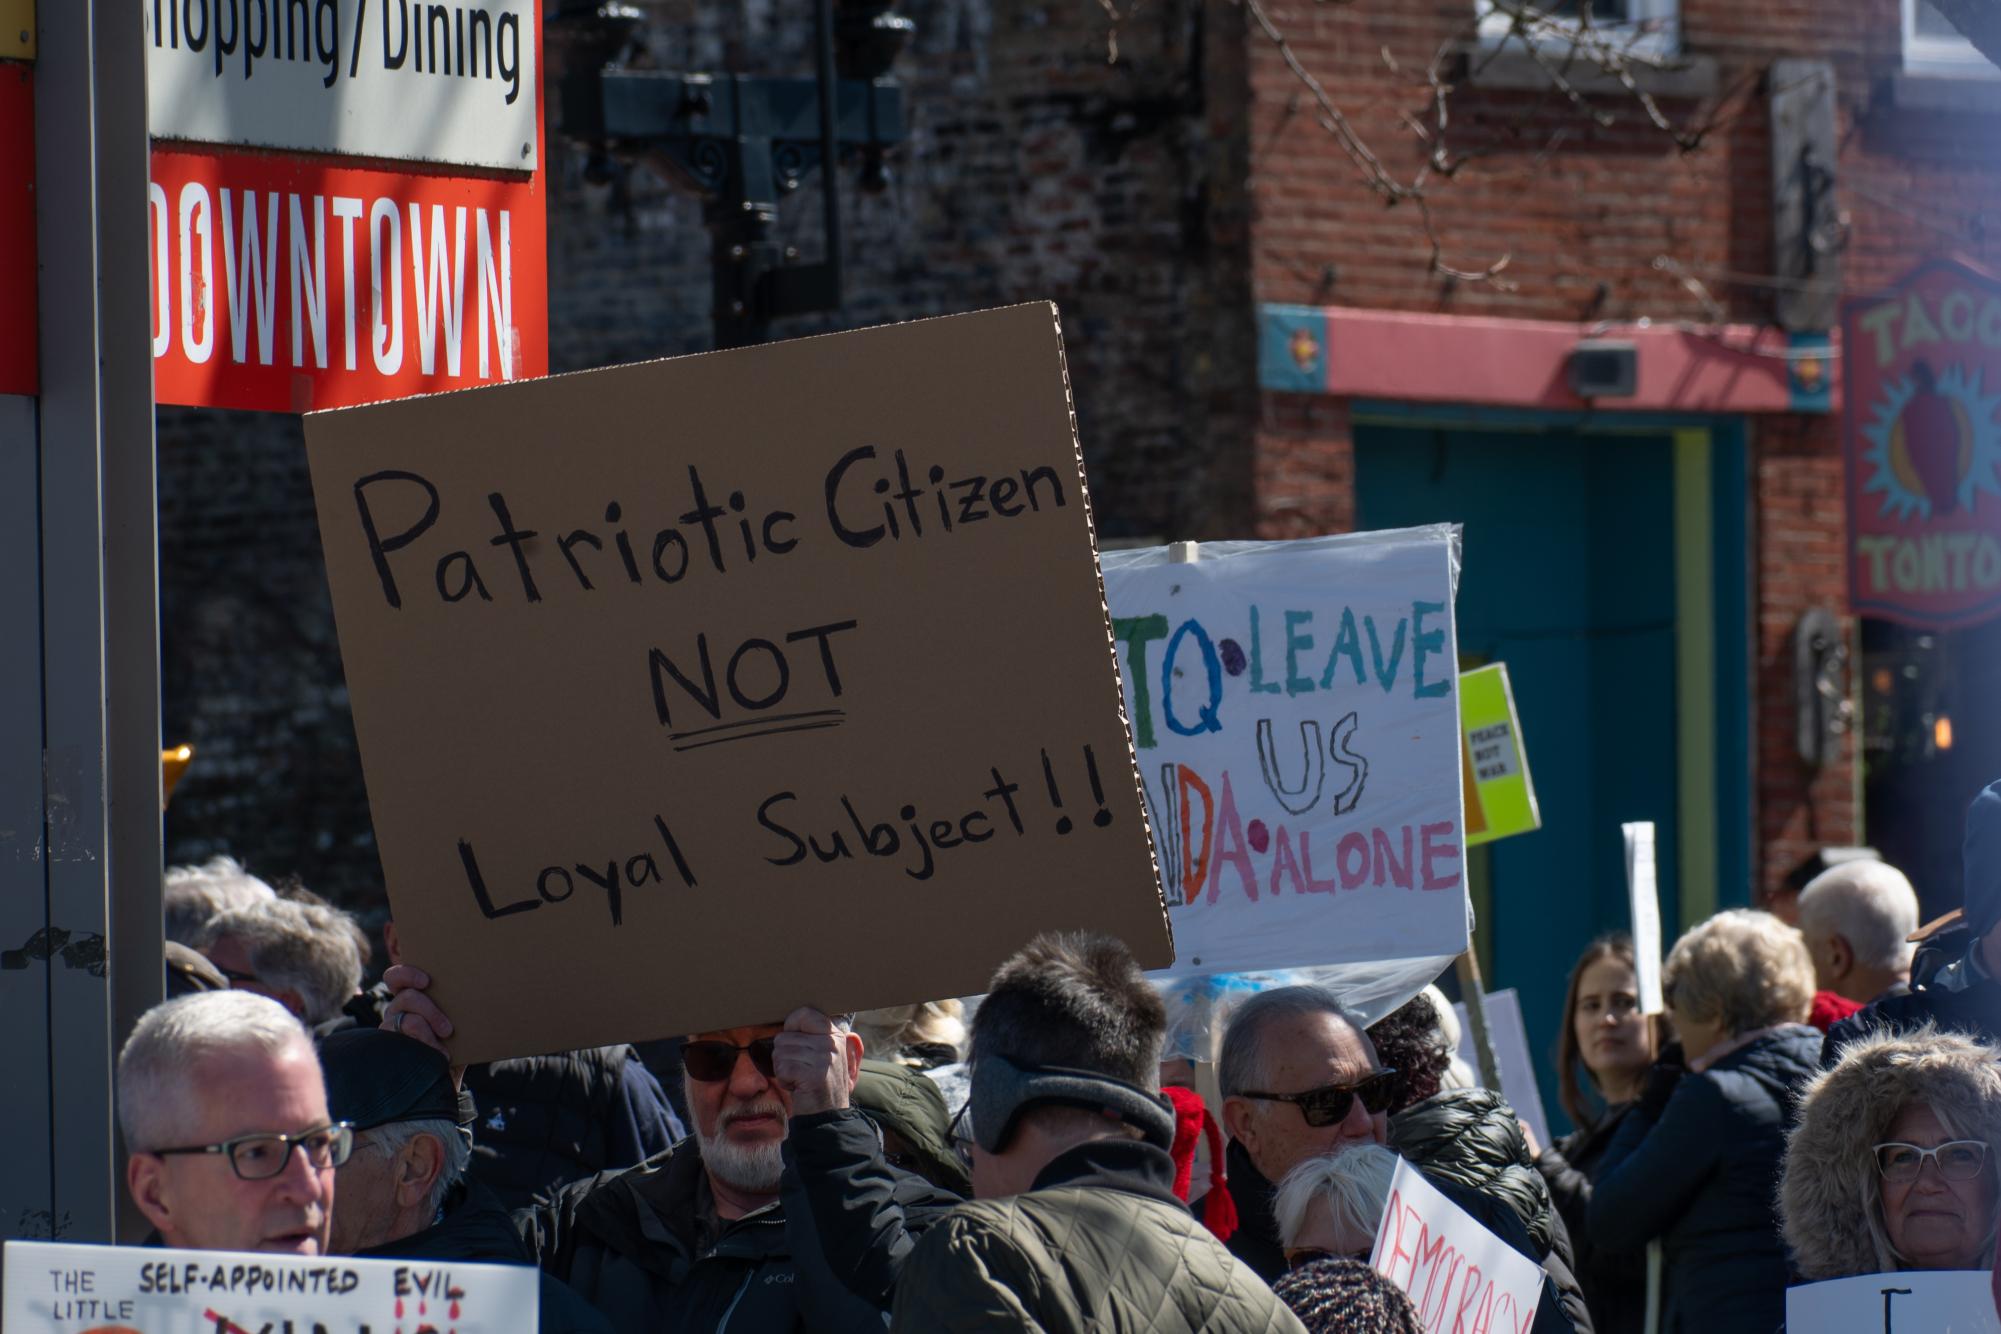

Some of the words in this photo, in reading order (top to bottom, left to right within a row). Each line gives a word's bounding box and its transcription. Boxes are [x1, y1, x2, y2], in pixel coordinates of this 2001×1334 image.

[150, 181, 513, 381] DOWNTOWN
[353, 465, 799, 608] Patriotic
[825, 445, 1066, 549] Citizen
[1857, 530, 2001, 594] TONTO
[648, 619, 858, 727] NOT
[1249, 600, 1452, 700] LEAVE
[1256, 711, 1368, 816] US
[458, 814, 698, 926] Loyal
[757, 744, 1113, 880] Subject!!
[1270, 820, 1461, 896] ALONE
[50, 1270, 96, 1293] THE
[138, 1262, 359, 1296] SELF-APPOINTED
[393, 1267, 465, 1299] EVIL
[53, 1300, 134, 1321] LITTLE
